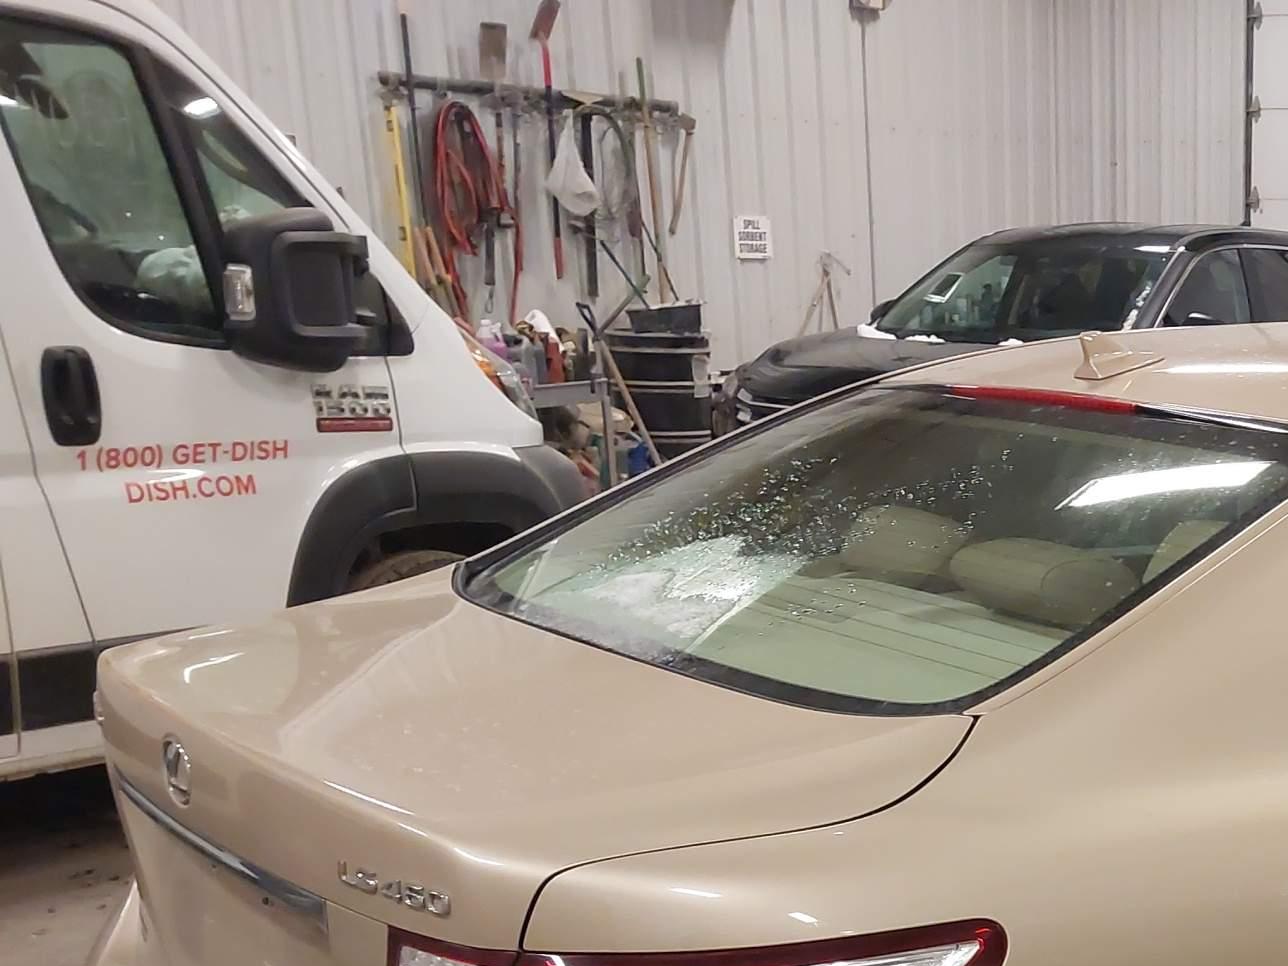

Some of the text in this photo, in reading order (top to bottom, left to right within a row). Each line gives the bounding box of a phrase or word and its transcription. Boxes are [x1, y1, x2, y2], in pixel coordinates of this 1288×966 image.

[743, 219, 760, 230] SPILL
[738, 231, 767, 241] SORBENT
[739, 243, 768, 254] STORAGE
[76, 440, 289, 472] 1 (800) GET-DISH
[125, 474, 257, 504] DISH.COM
